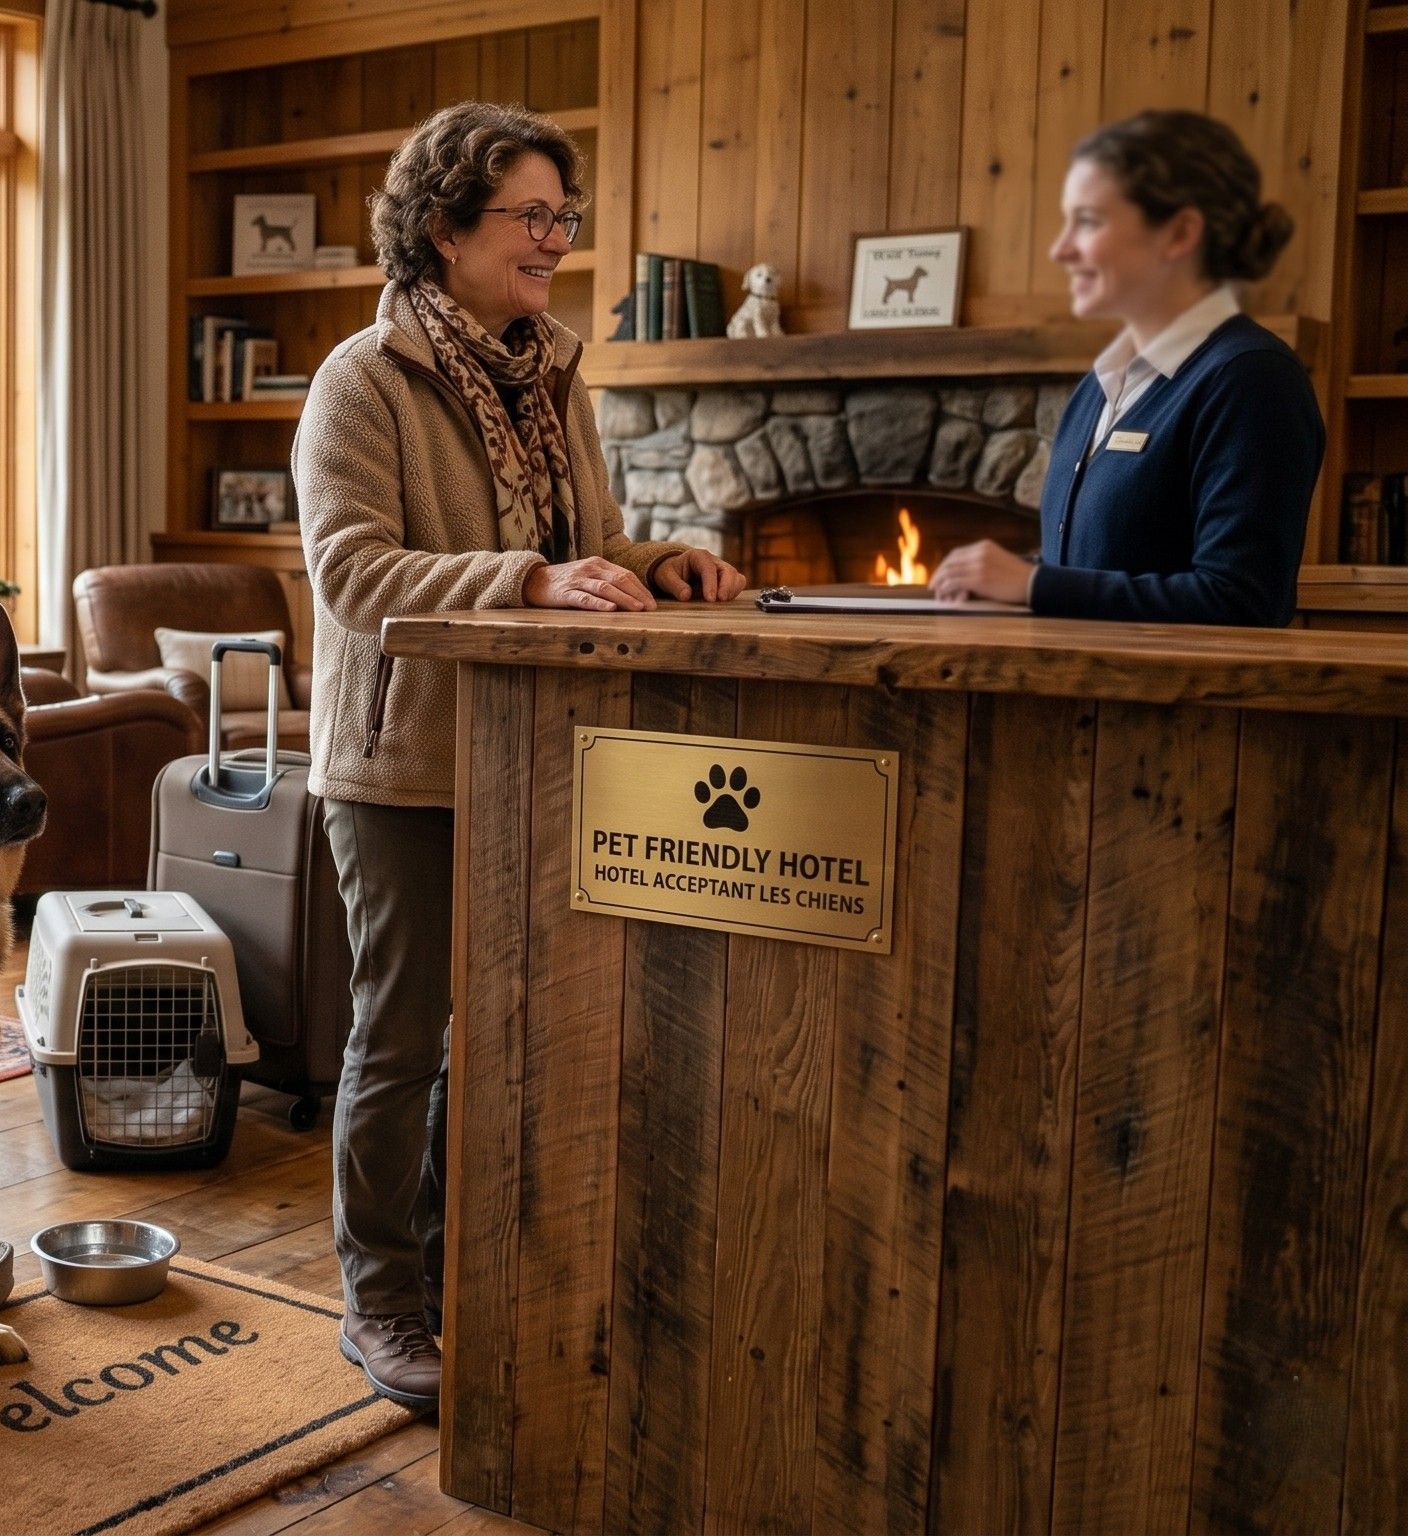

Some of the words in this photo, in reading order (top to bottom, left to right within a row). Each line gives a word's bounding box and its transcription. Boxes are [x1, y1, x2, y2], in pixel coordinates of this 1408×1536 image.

[593, 829, 639, 858] PET
[645, 835, 772, 874] FRIENDLY
[779, 850, 871, 887] HOTEL
[594, 863, 649, 887] HOTEL
[652, 871, 756, 901] ACCEPTANT
[759, 884, 791, 906] LES
[795, 889, 865, 915] CHIENS
